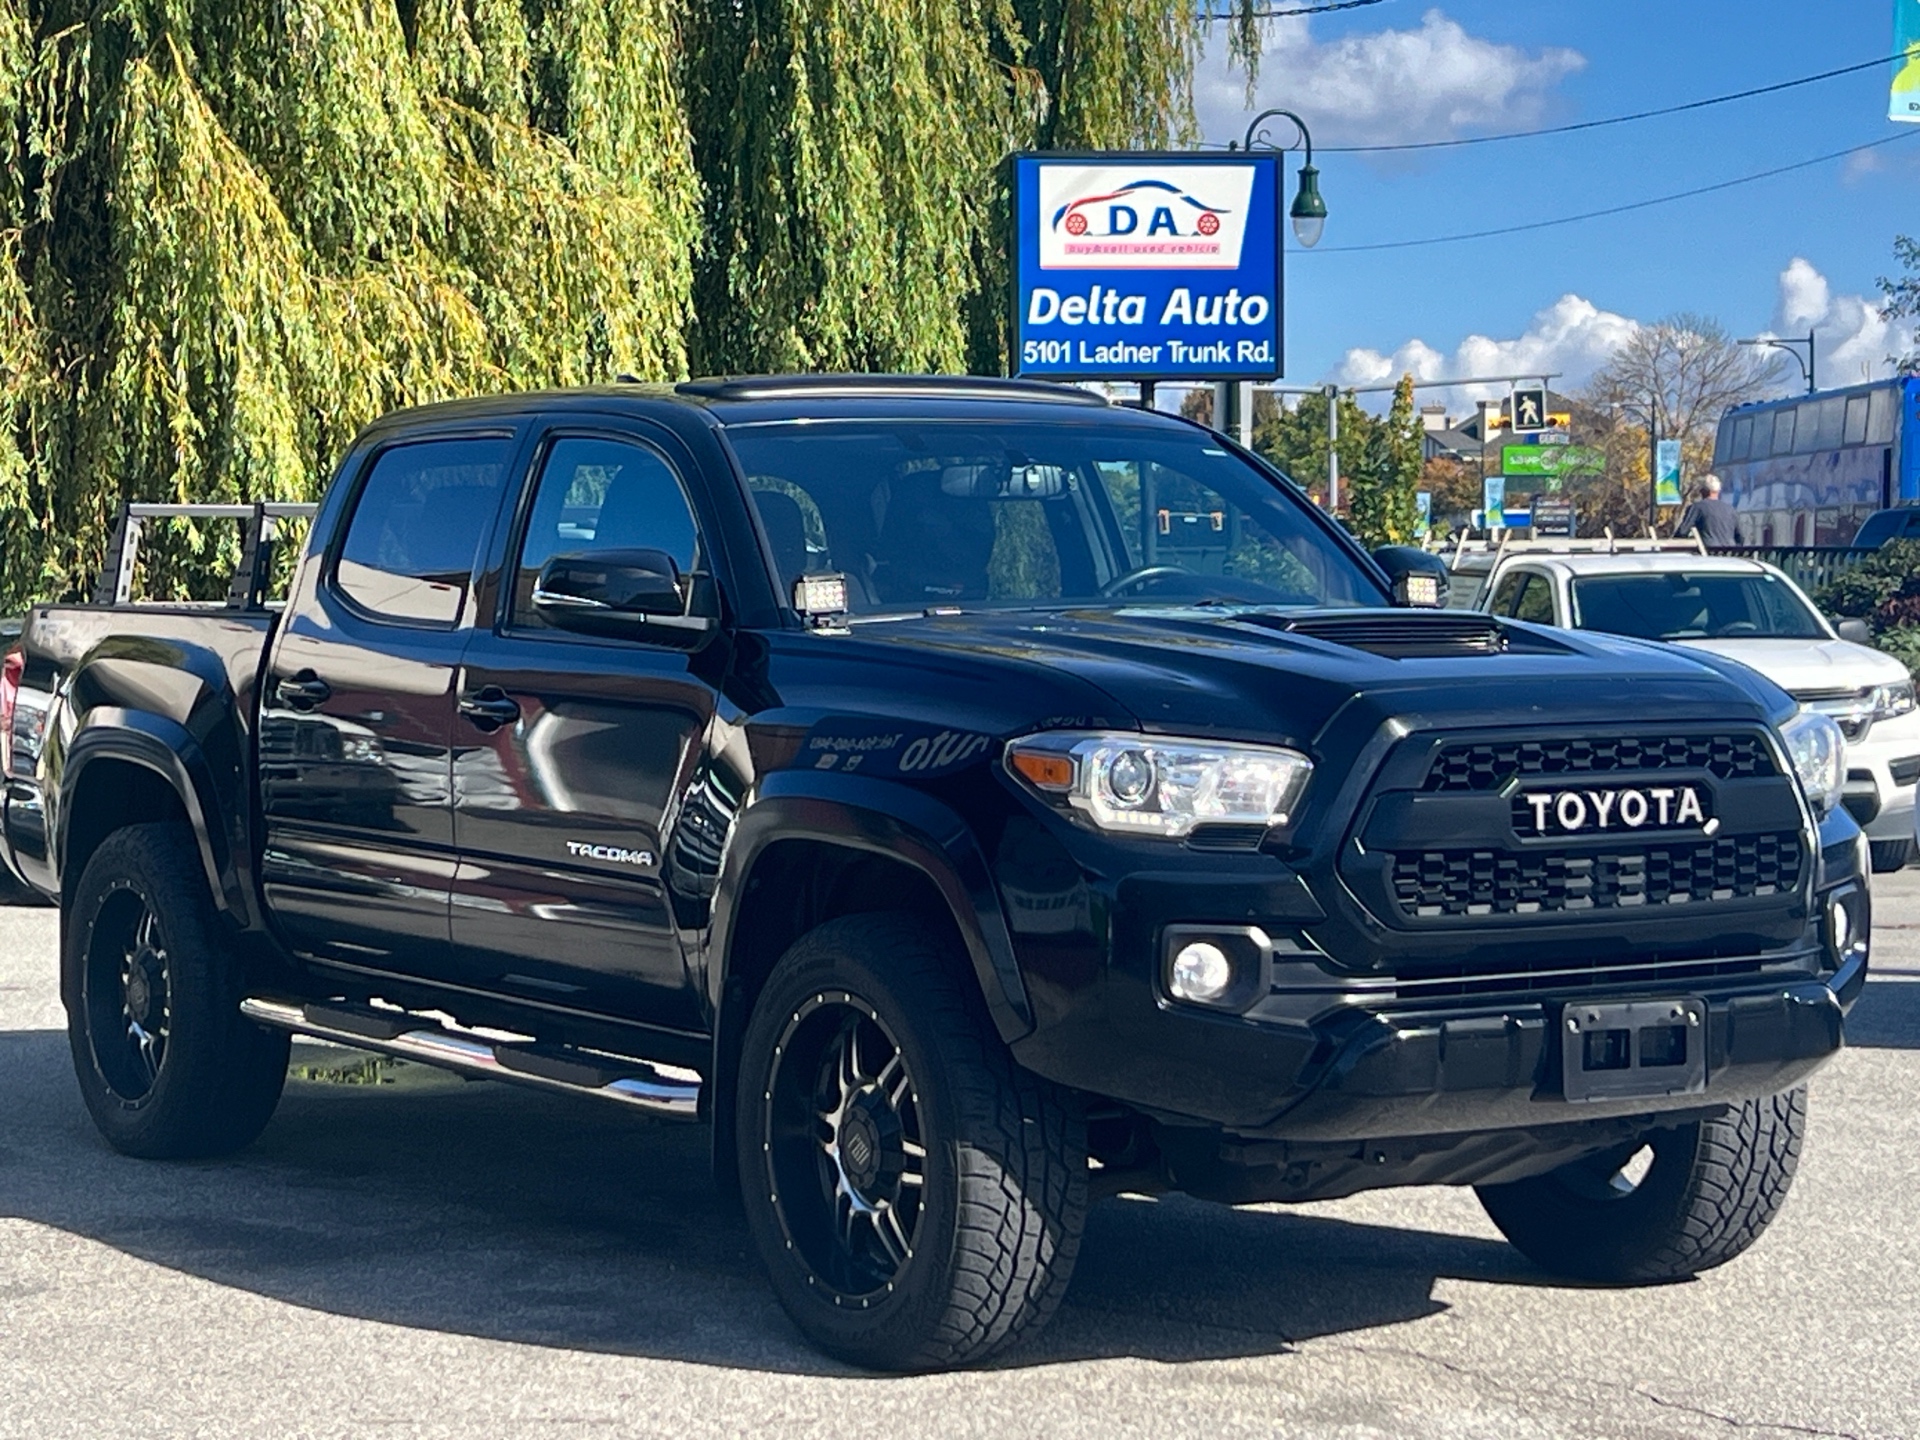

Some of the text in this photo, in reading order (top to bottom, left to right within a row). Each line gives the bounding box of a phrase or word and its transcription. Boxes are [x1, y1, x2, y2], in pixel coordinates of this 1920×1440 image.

[1028, 285, 1268, 326] Delta Auto
[1024, 340, 1275, 363] 5101 Ladner Trunk Rd.
[1527, 788, 1703, 831] TOYOTA
[565, 841, 652, 866] TACOMA
